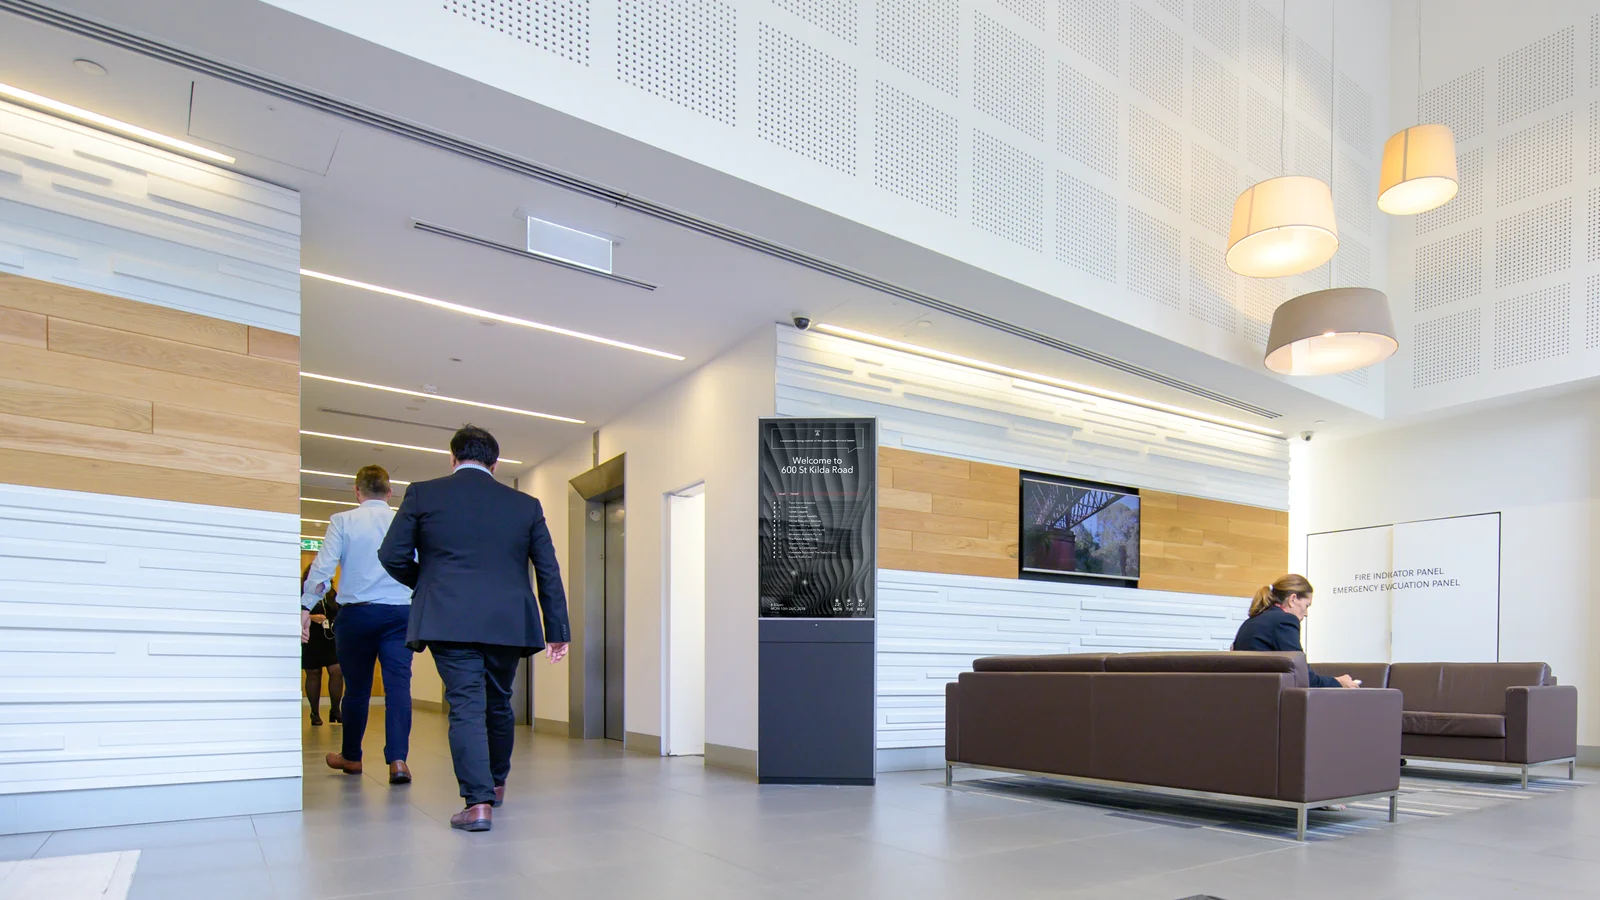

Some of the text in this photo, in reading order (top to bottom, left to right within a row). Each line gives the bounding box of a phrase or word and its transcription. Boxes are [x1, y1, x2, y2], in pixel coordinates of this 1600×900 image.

[792, 457, 832, 465] Welcome
[781, 466, 854, 474] 600 St Kilda Road
[1354, 573, 1371, 581] FIRE
[1417, 568, 1444, 576] PANEL
[1332, 585, 1378, 594] EMERGENCY
[1432, 579, 1460, 587] PANEL
